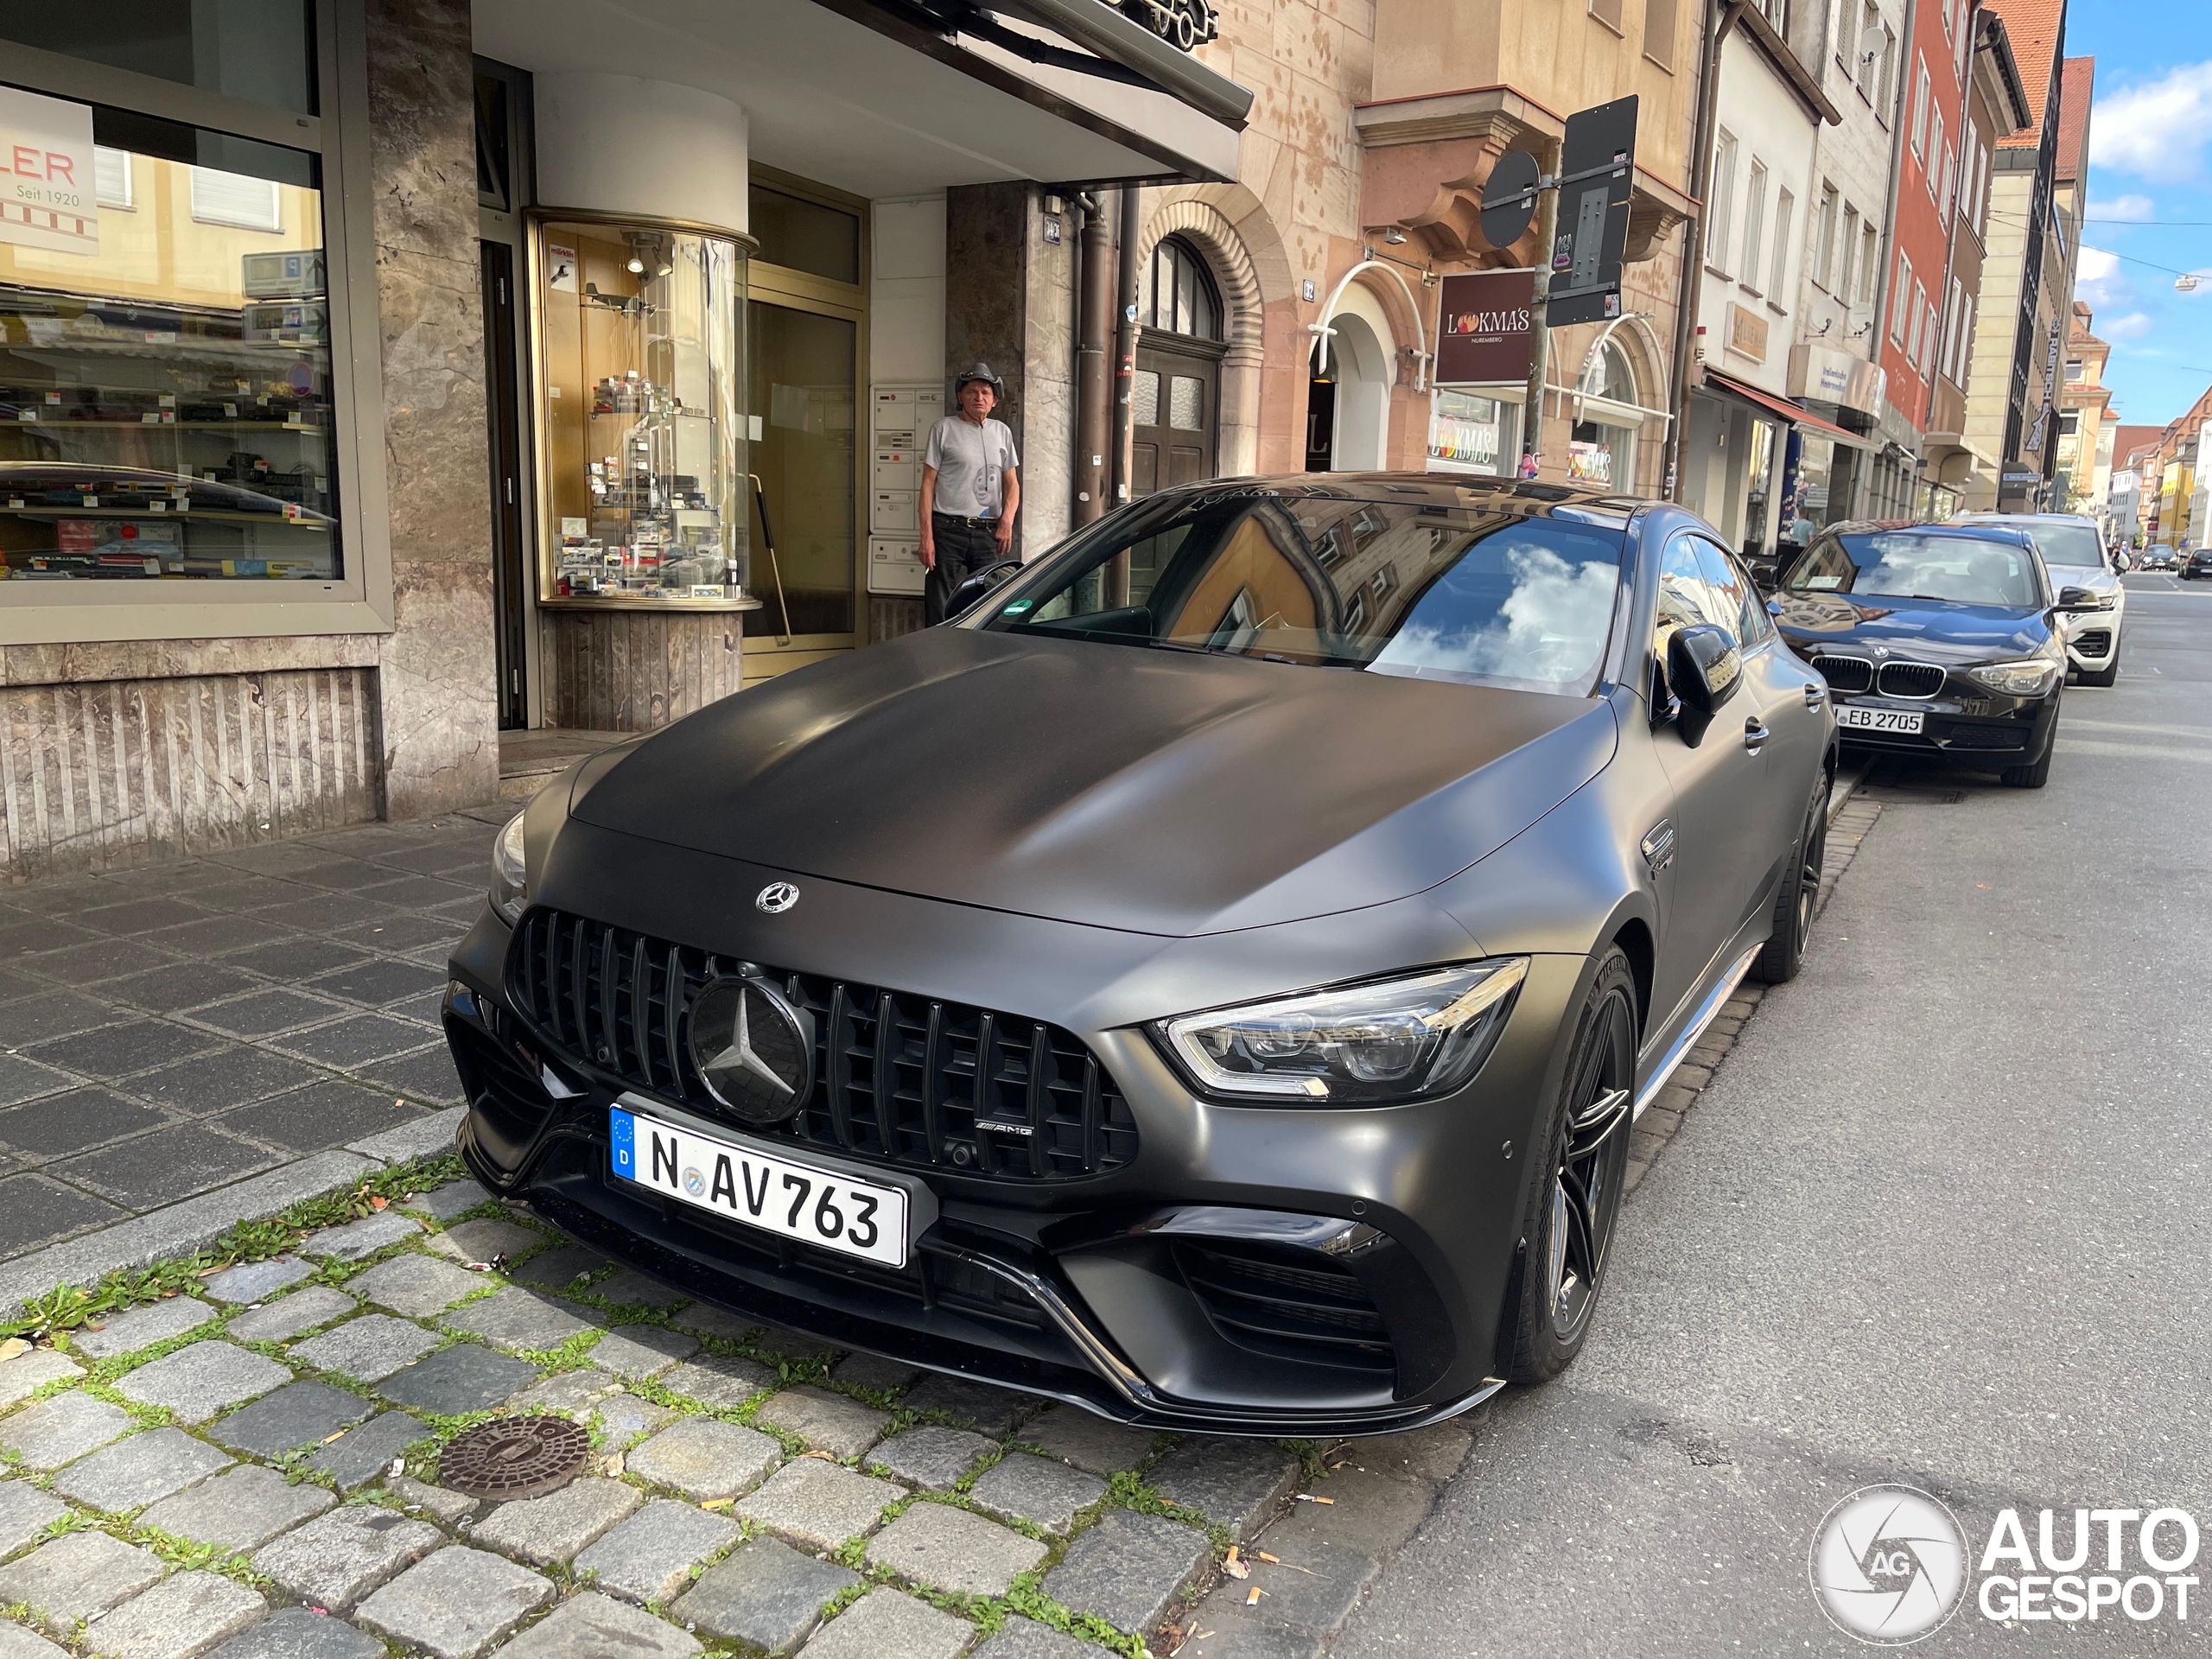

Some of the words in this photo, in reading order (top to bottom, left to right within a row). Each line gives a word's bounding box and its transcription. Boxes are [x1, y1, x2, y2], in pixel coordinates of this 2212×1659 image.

[17, 185, 41, 200] Seit
[47, 190, 79, 207] 1920
[2044, 337, 2057, 401] RABITSCH
[1849, 709, 1871, 726] EB
[1875, 713, 1920, 730] 2705
[994, 1124, 1033, 1135] AMG
[620, 1149, 629, 1166] D
[652, 1131, 677, 1188] N
[711, 1154, 770, 1217] AV
[783, 1173, 878, 1248] 763
